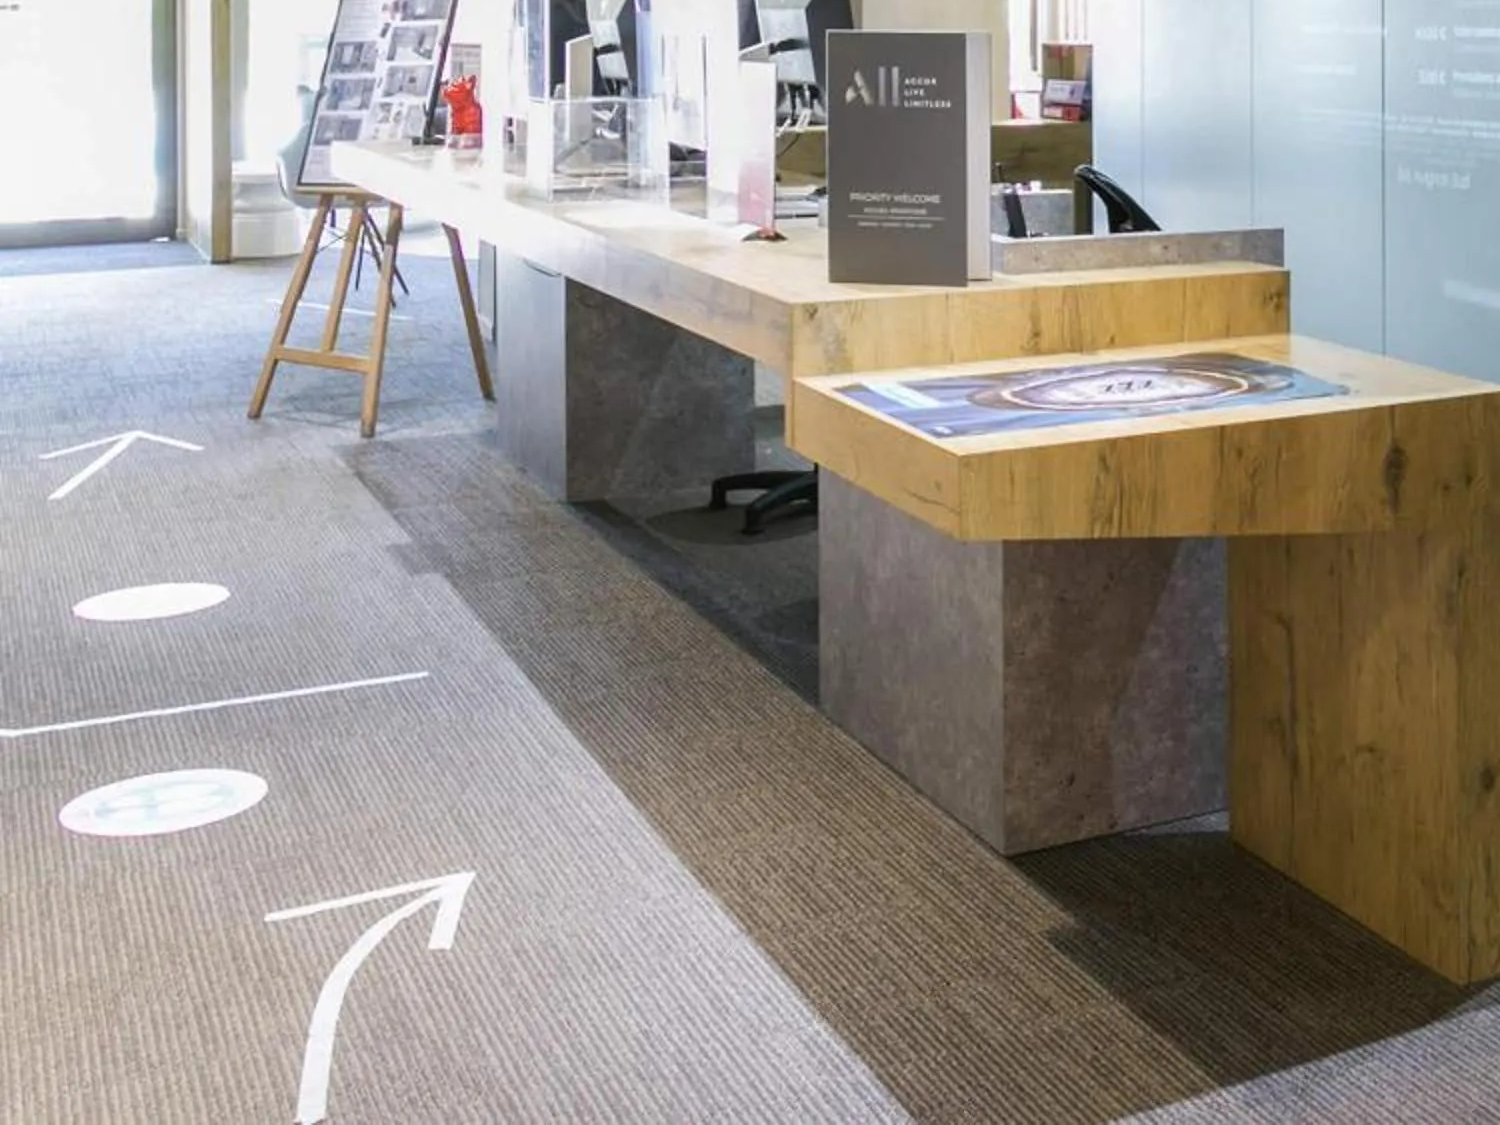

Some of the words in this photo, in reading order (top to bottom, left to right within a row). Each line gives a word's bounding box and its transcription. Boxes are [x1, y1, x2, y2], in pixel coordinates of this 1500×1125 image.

[904, 77, 937, 86] ACCOR
[904, 88, 926, 97] LIVE
[904, 99, 952, 108] LIMITLESS
[849, 192, 891, 202] PRIORITY
[893, 193, 941, 204] WELCOME
